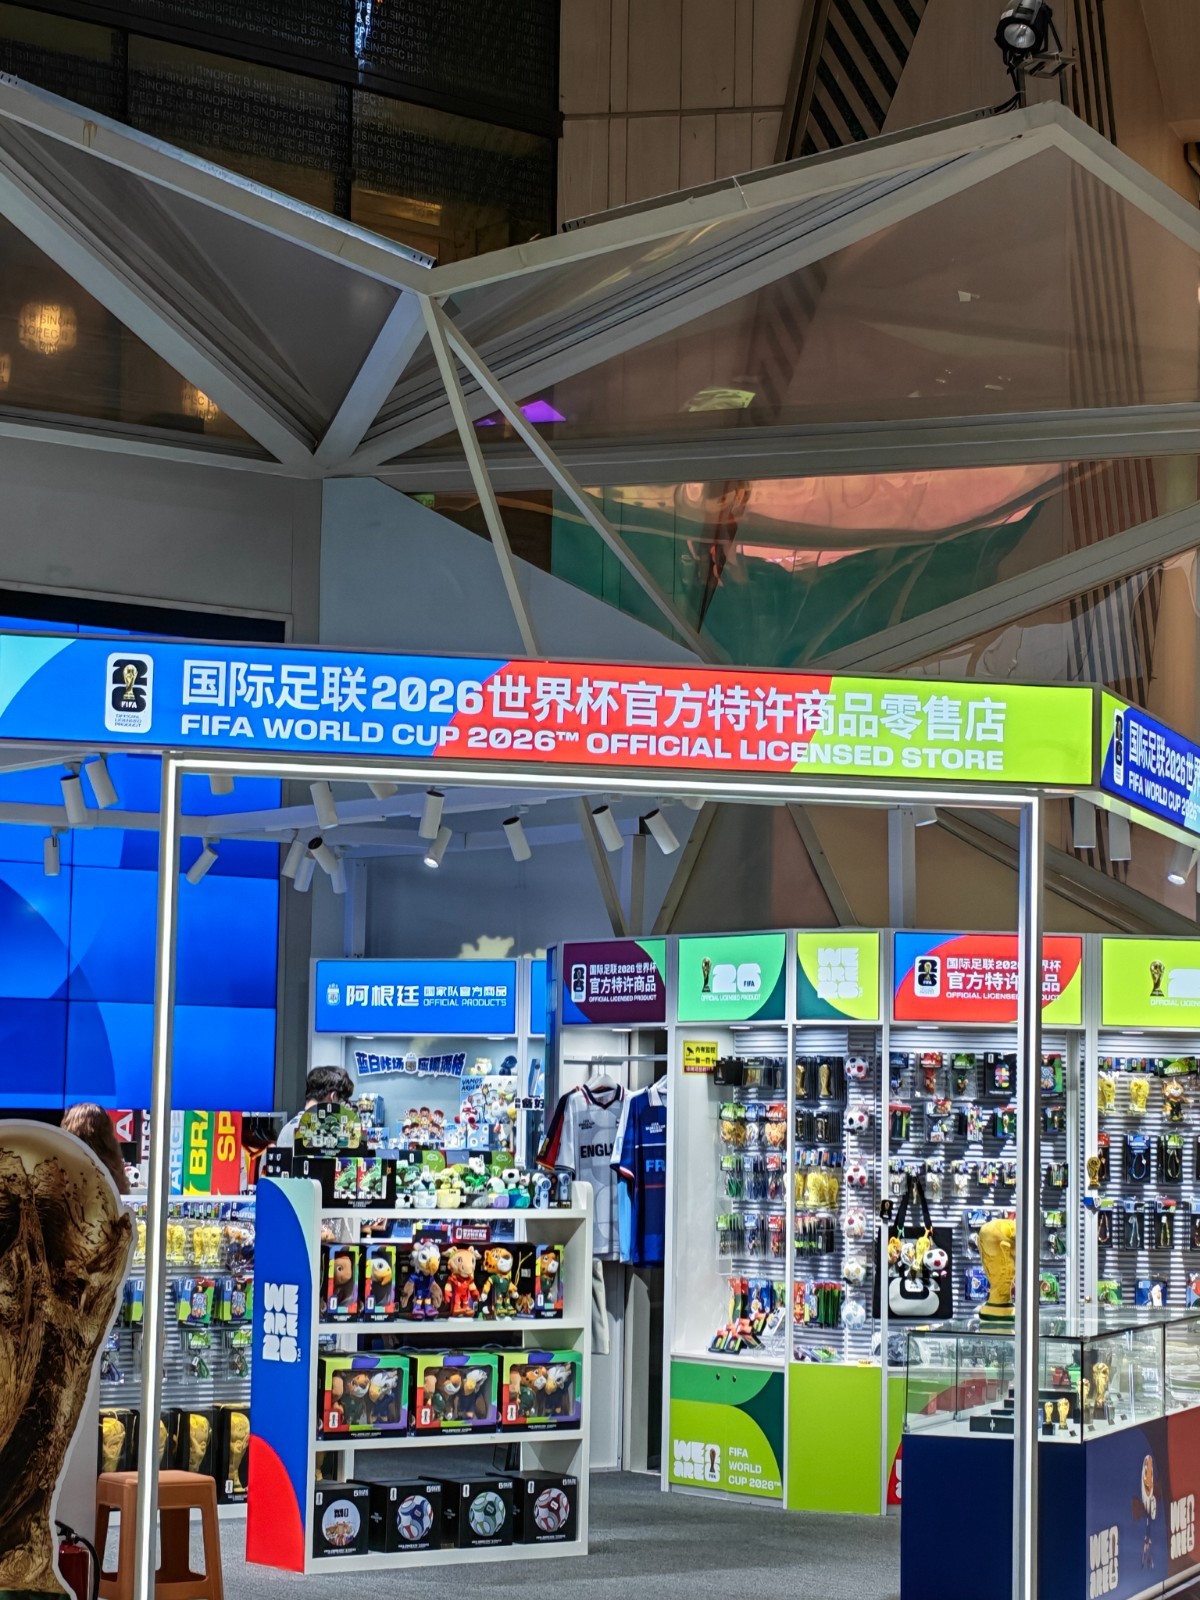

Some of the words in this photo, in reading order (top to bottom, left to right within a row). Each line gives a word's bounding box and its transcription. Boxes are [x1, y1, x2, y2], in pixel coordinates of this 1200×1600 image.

[182, 659, 1006, 743] 国际足联2026世界杯官方特许商品零售店
[181, 713, 254, 738] FIFA
[263, 717, 384, 743] WORLD
[392, 724, 460, 747] CUP
[586, 732, 732, 759] OFFICIAL
[740, 740, 893, 767] LICENSED
[901, 747, 1003, 771] STORE
[1128, 770, 1143, 795] FIFA
[1144, 778, 1167, 806] WORLD
[1168, 790, 1181, 812] CUP
[423, 985, 507, 997] 国家队官方商品
[589, 975, 656, 994] 官方特许商品
[346, 985, 419, 1007] 阿根廷
[423, 998, 459, 1006] OFFICIAL
[461, 998, 507, 1006] PRODUCTS
[946, 991, 982, 999] OFFICIAL
[264, 1282, 299, 1314] WE
[728, 1447, 748, 1458] FIFA
[728, 1460, 761, 1474] WORLD
[728, 1475, 747, 1486] CUP
